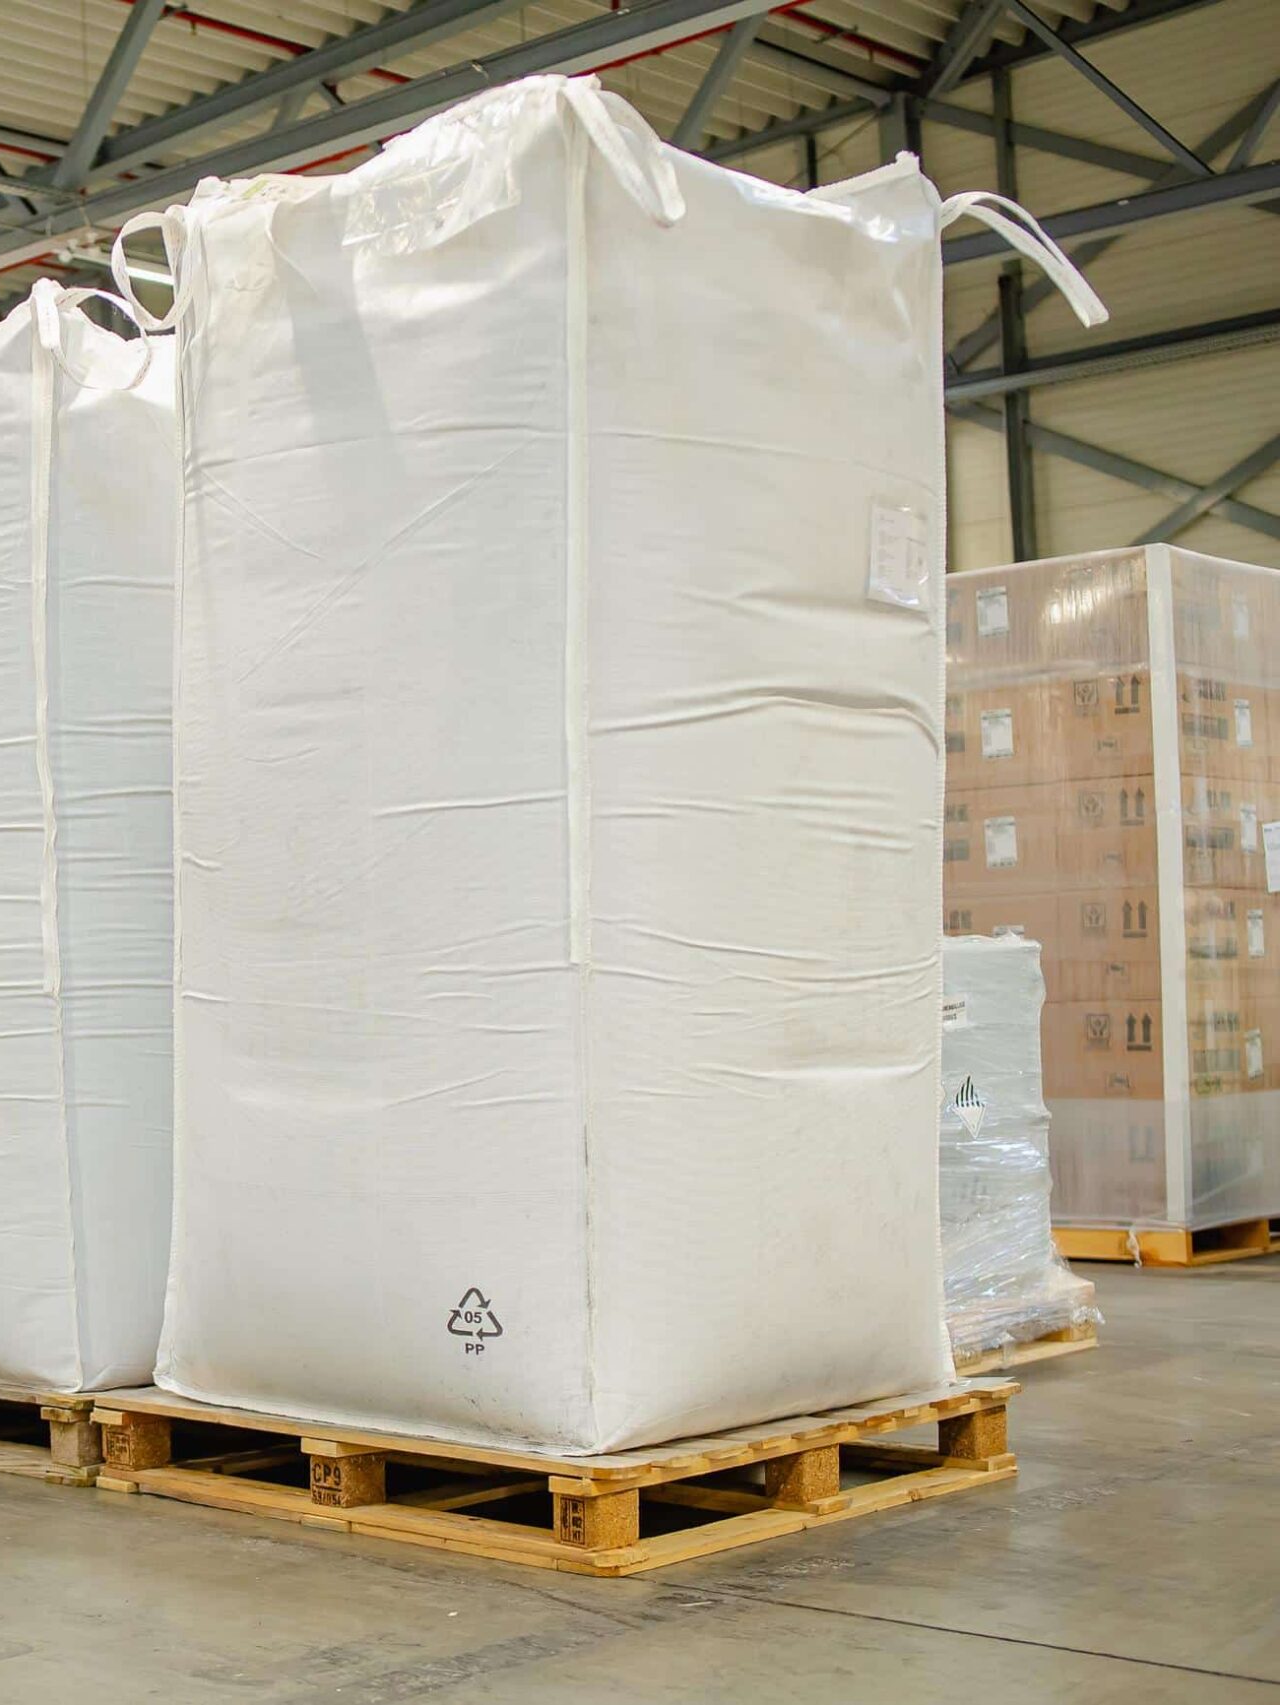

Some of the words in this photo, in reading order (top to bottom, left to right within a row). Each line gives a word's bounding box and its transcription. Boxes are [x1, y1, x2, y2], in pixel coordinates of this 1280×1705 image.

[464, 1311, 482, 1323] 05
[465, 1343, 485, 1355] PP
[313, 1463, 341, 1486] CP9
